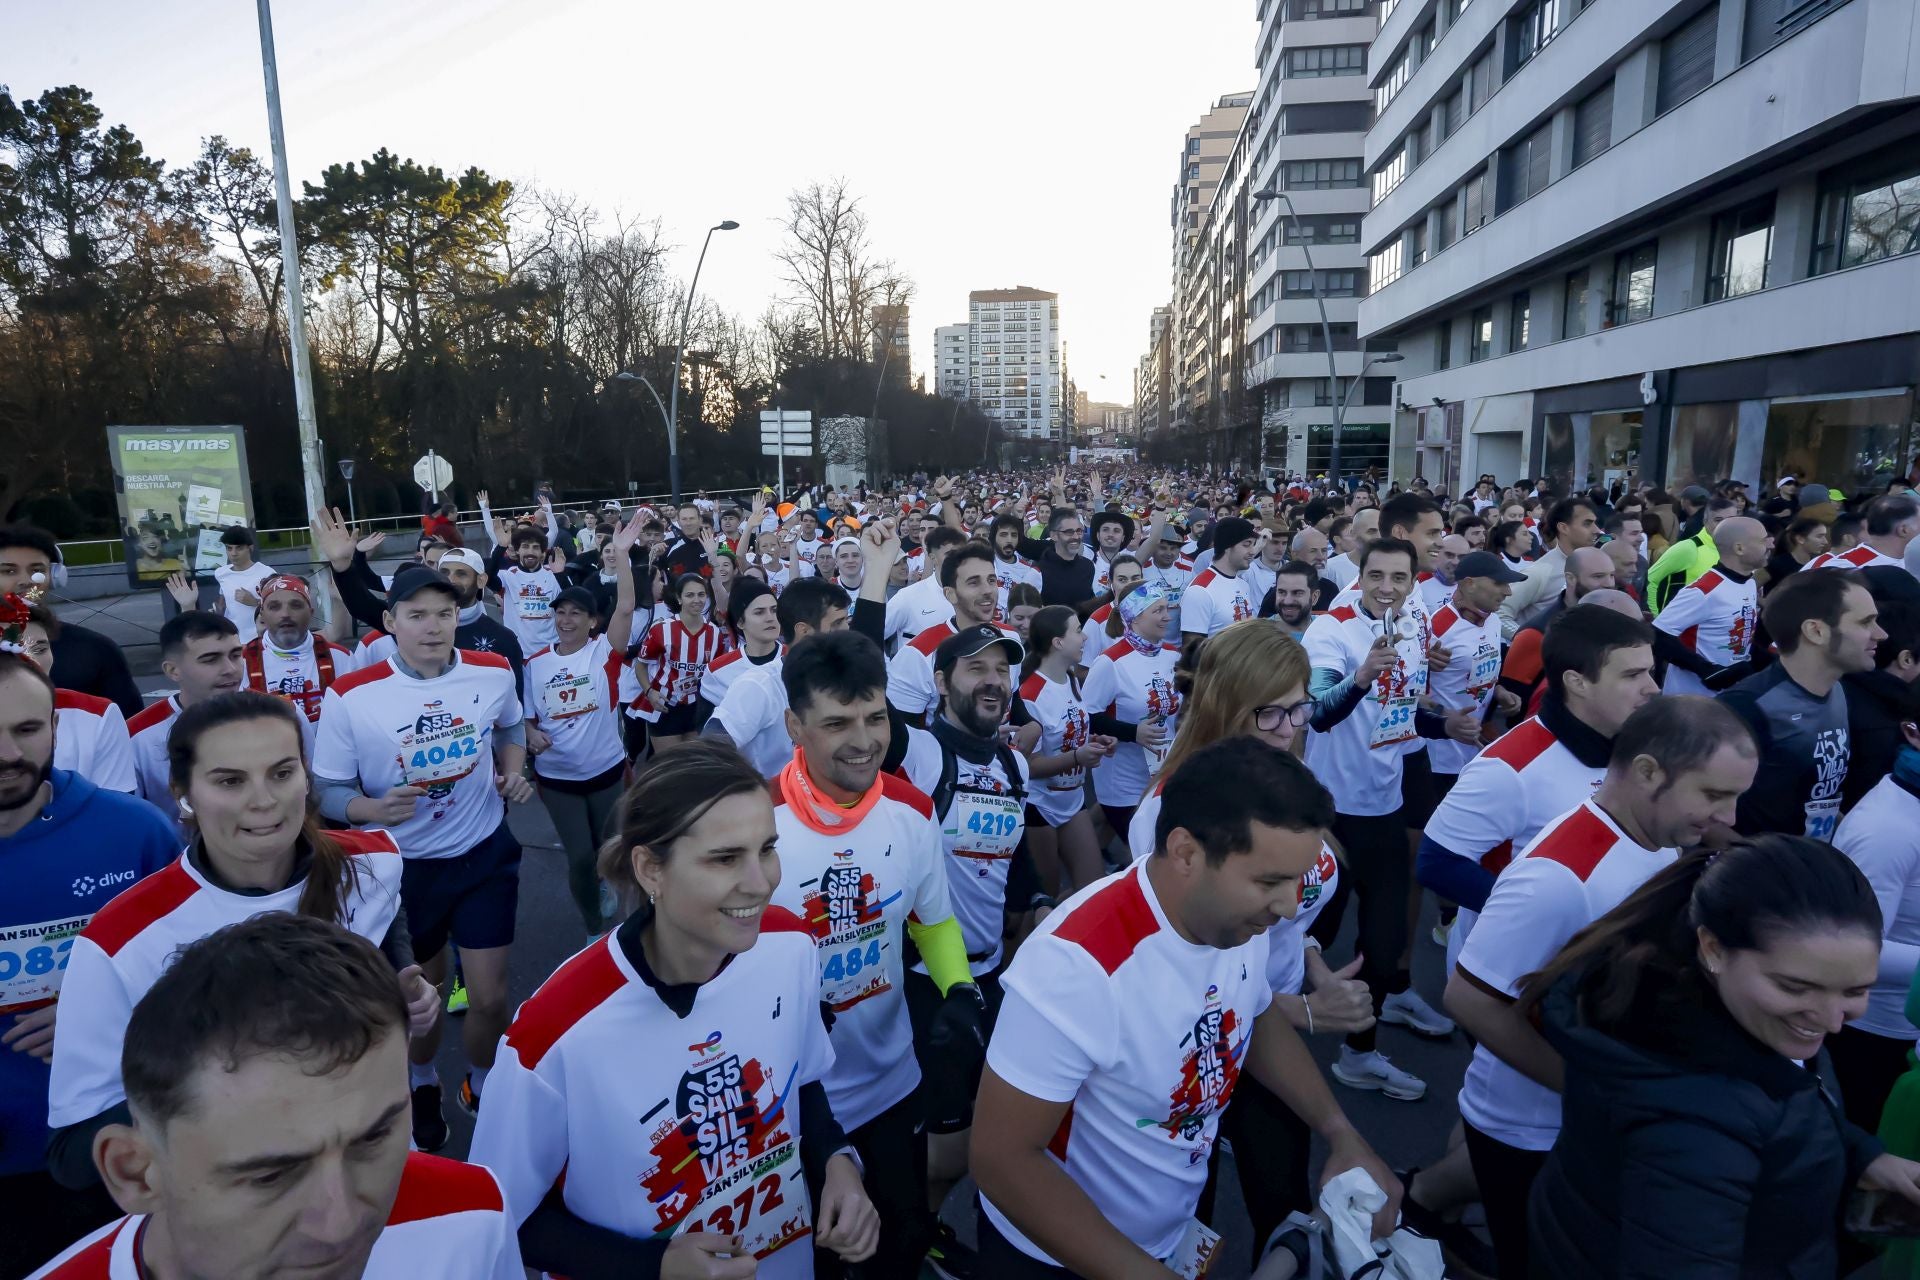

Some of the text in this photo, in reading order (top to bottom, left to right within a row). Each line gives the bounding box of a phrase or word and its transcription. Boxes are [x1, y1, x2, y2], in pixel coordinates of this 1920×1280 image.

[126, 474, 170, 483] DESCARGA
[127, 481, 183, 490] NUESTRA APP
[524, 602, 547, 611] 3716
[283, 684, 304, 695] SAN
[558, 687, 578, 704] 97
[431, 714, 452, 729] 55
[425, 734, 441, 743] SAN
[440, 723, 475, 739] SILVESTRE
[410, 736, 478, 768] 4042
[980, 797, 994, 806] SAN
[967, 810, 1017, 837] 4219
[99, 869, 135, 887] diva
[839, 868, 861, 886] 55
[827, 881, 859, 900] SAN
[829, 898, 858, 920] SIL
[19, 918, 89, 940] SILVESTRE
[824, 934, 844, 948] SAN
[845, 920, 887, 942] SILVESTRE
[692, 1050, 726, 1069] TotalEnergies
[1198, 1045, 1223, 1077] SIL
[705, 1058, 742, 1095] 55
[1199, 1067, 1224, 1101] VES
[688, 1085, 744, 1125] SAN
[697, 1111, 747, 1156] SIL
[700, 1136, 749, 1184] VES
[706, 1141, 794, 1200] SAN SILVESTRE
